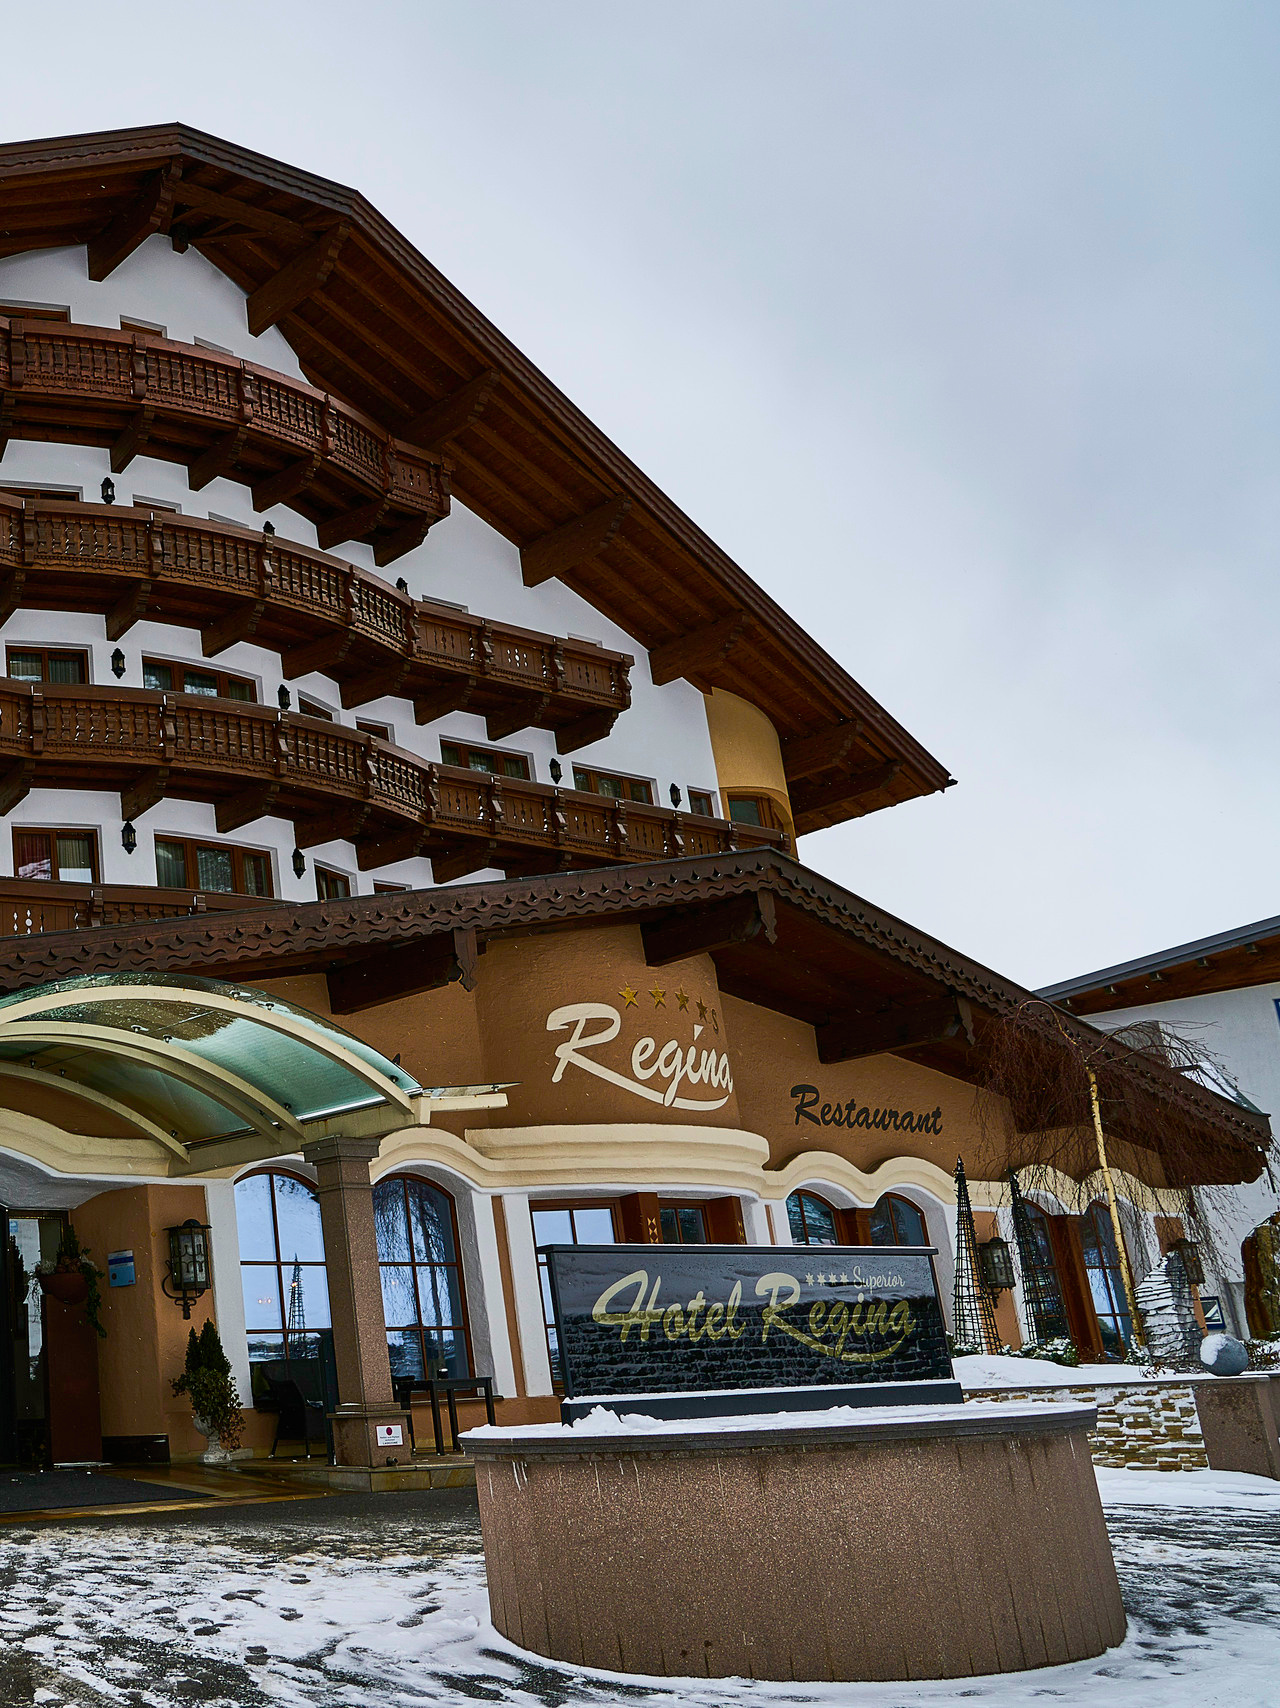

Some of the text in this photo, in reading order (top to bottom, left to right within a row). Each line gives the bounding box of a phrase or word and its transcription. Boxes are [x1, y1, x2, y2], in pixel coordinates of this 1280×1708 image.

[546, 1002, 734, 1111] Regina
[790, 1084, 943, 1136] Restaurant
[592, 1269, 916, 1362] Hotel Regina
[853, 1265, 906, 1295] Superior
